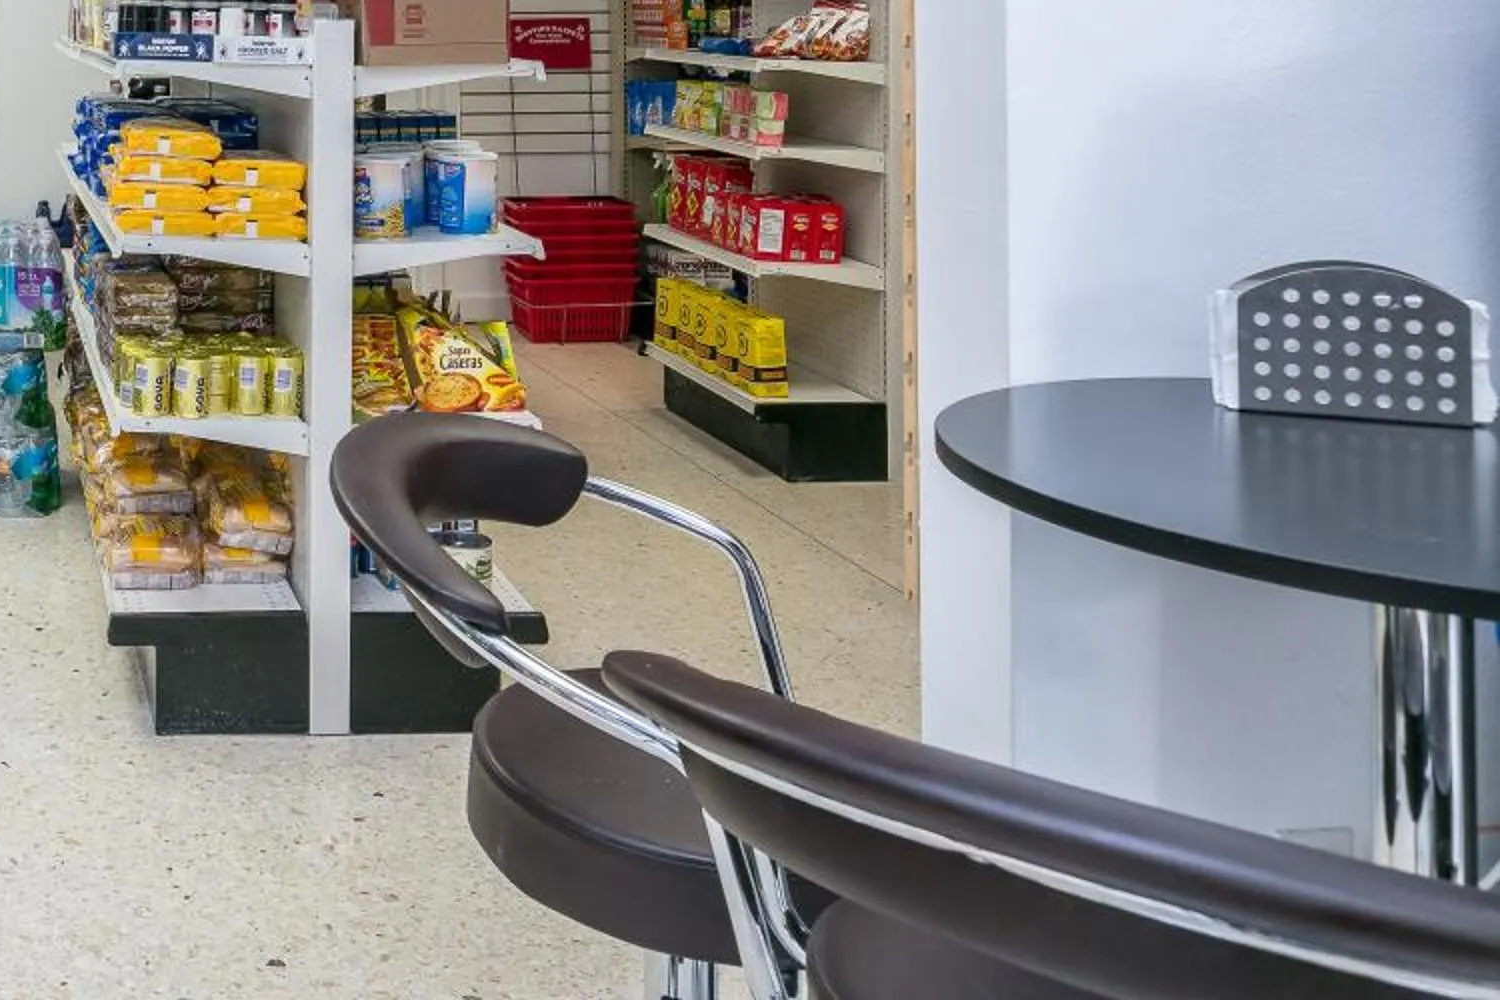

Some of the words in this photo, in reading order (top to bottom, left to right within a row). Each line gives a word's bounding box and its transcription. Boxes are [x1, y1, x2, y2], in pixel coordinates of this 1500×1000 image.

[440, 354, 483, 370] Caseras
[153, 375, 164, 412] GOYA
[195, 377, 206, 413] GOYA
